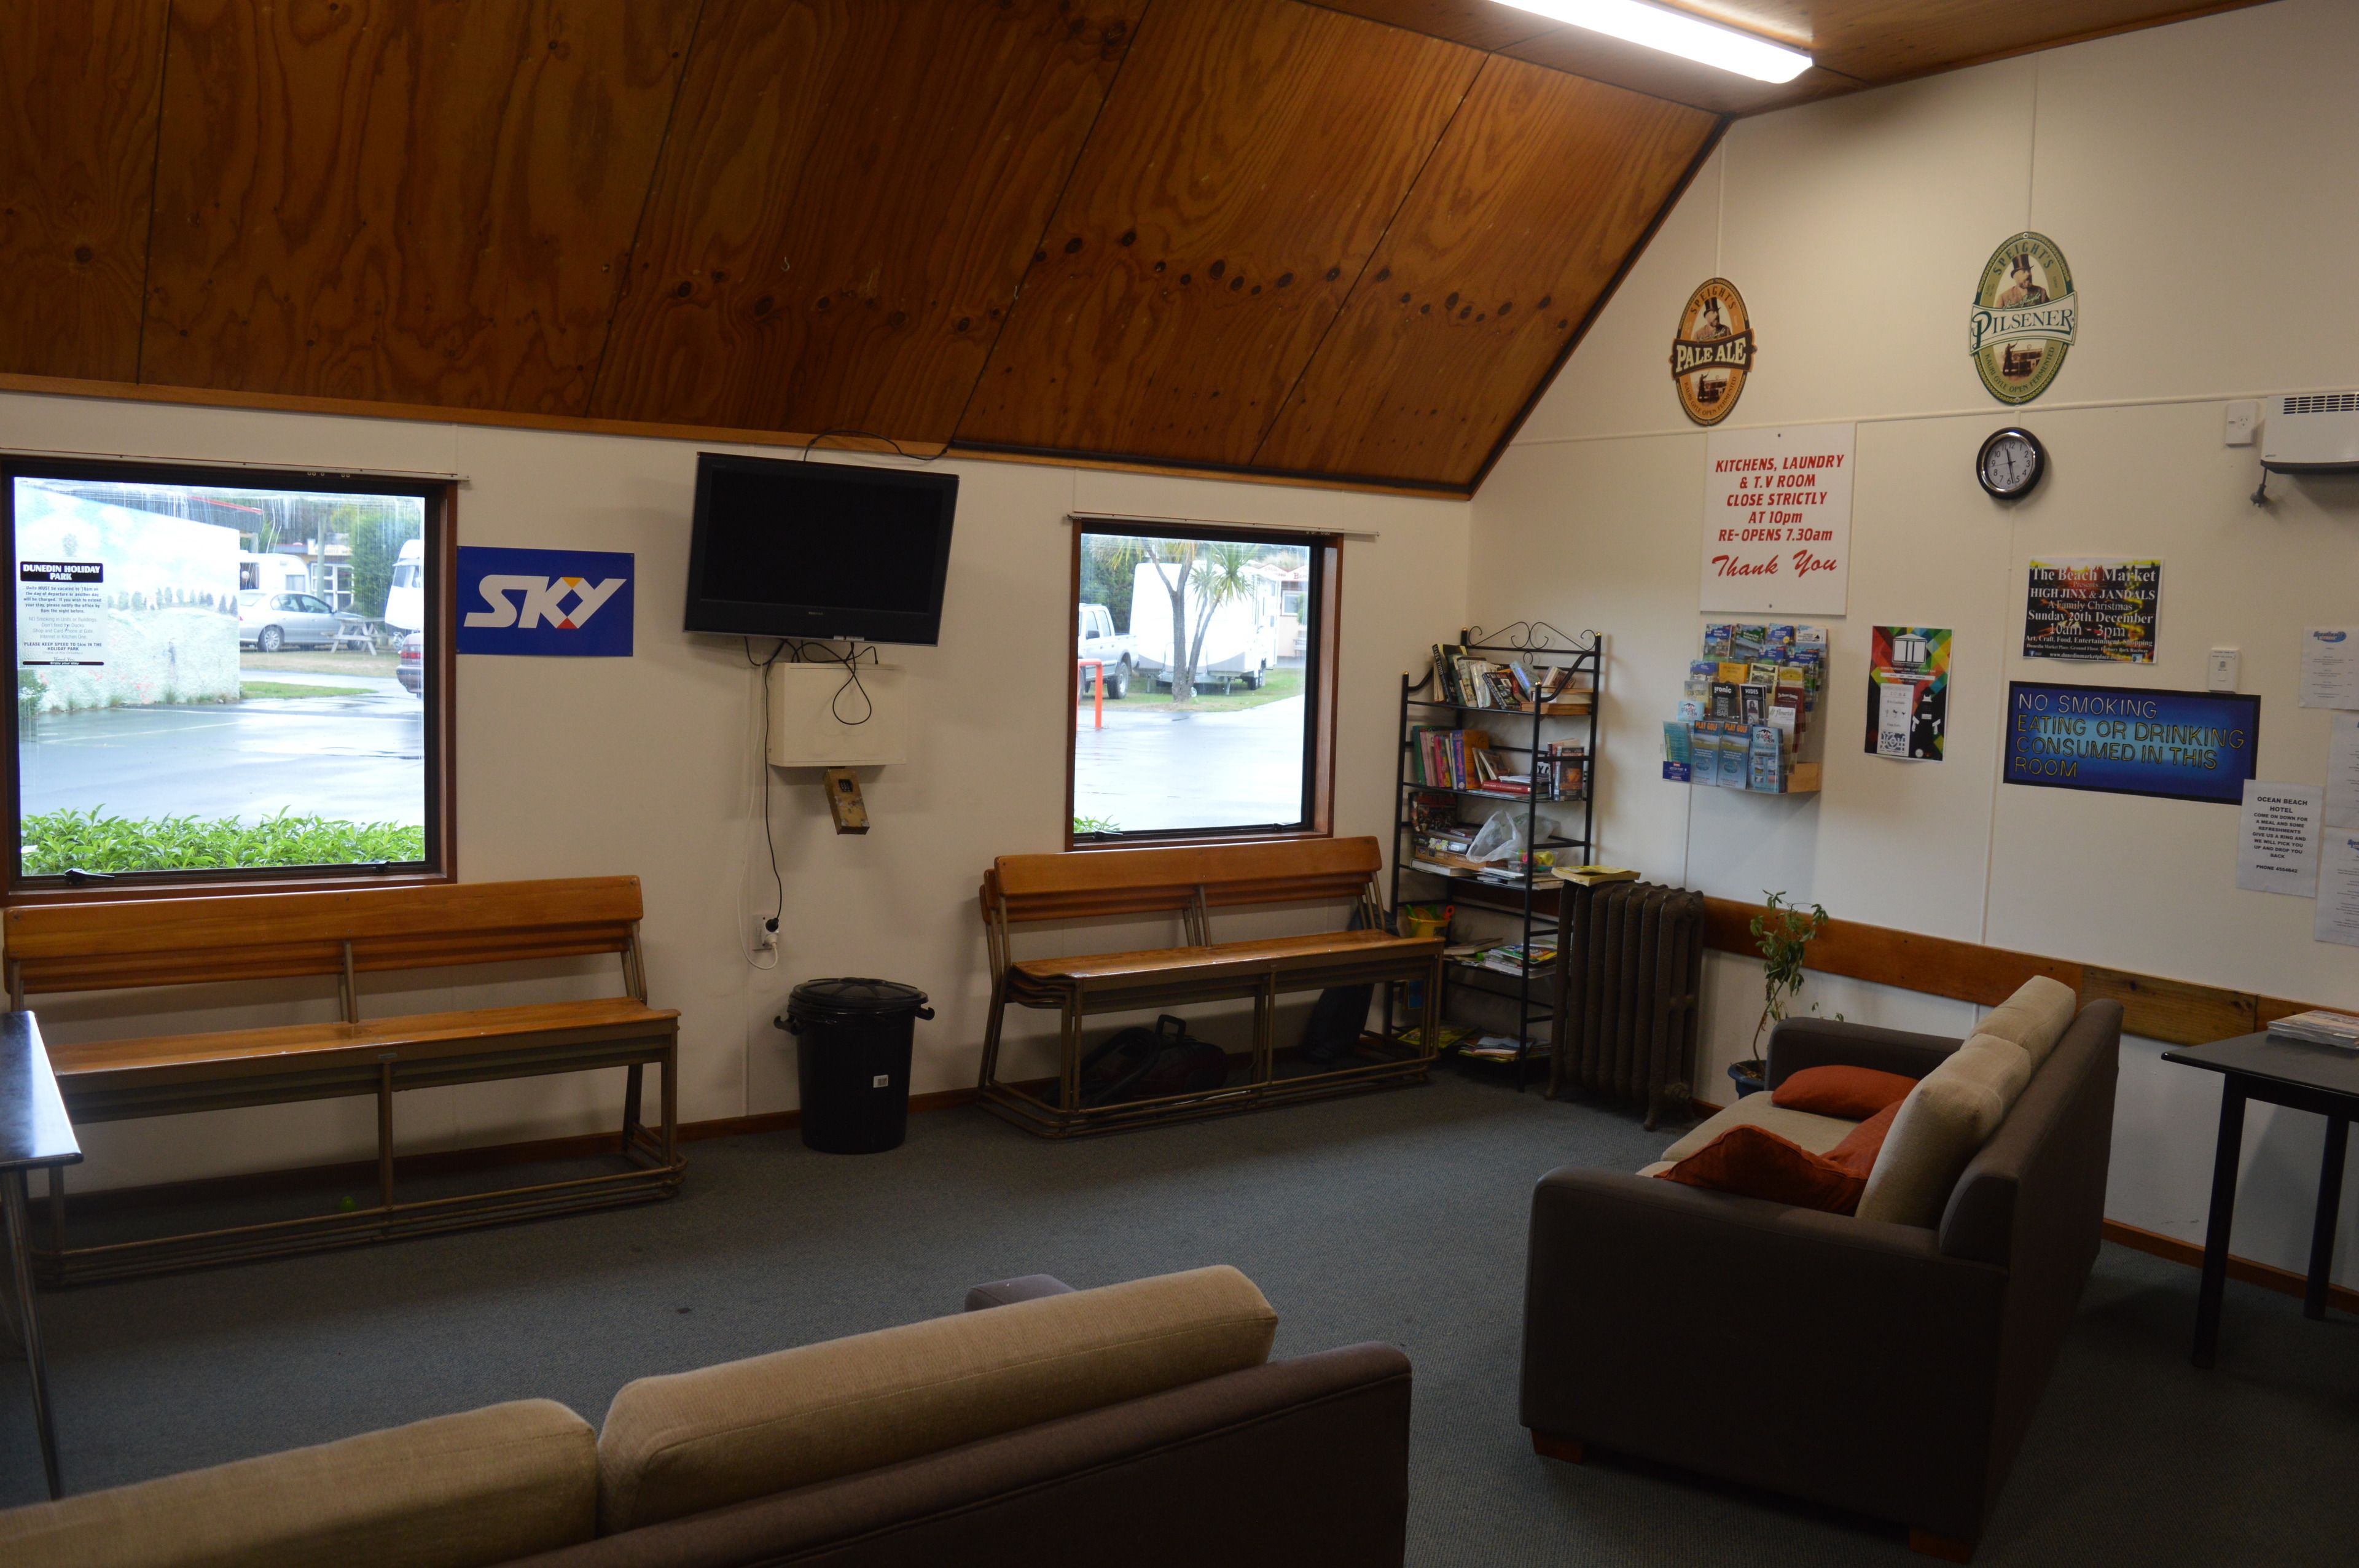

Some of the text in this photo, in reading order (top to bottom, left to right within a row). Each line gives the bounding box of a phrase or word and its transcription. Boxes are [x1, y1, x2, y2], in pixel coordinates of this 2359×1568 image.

[1993, 241, 2054, 276] SPEIGHT'S
[1691, 286, 1736, 314] SPEIGHT'S
[1971, 308, 2075, 349] PILSENER
[1676, 337, 1747, 373] PALE ALE
[2029, 346, 2056, 387] FERMENTED
[1715, 454, 1844, 472] KITCHENS, LAUNDRY
[1740, 474, 1816, 489] & T.V ROOM
[1726, 491, 1828, 507] CLOSE STRICTLY
[1748, 511, 1802, 525] AT 10pm
[1786, 528, 1833, 541] 7.30am
[1712, 549, 1837, 578] Thank You
[2032, 568, 2156, 582] The Beach Market
[463, 574, 627, 629] SKY
[2030, 588, 2155, 600] HIGH JINX & JANDALS
[2057, 601, 2086, 610] Family
[2087, 601, 2132, 610] Christmas
[2028, 610, 2153, 623] Sunday 20th December
[2050, 623, 2082, 635] 10am
[2097, 625, 2126, 639] 3pm
[2019, 693, 2158, 719] NO SMOKING
[1696, 721, 1707, 730] PLAY
[1725, 722, 1747, 733] PLAY GOLF
[2017, 714, 2245, 749] EATING OR DRINKING
[2016, 736, 2217, 770] CONSUMED IN THIS
[2014, 757, 2078, 778] ROOM
